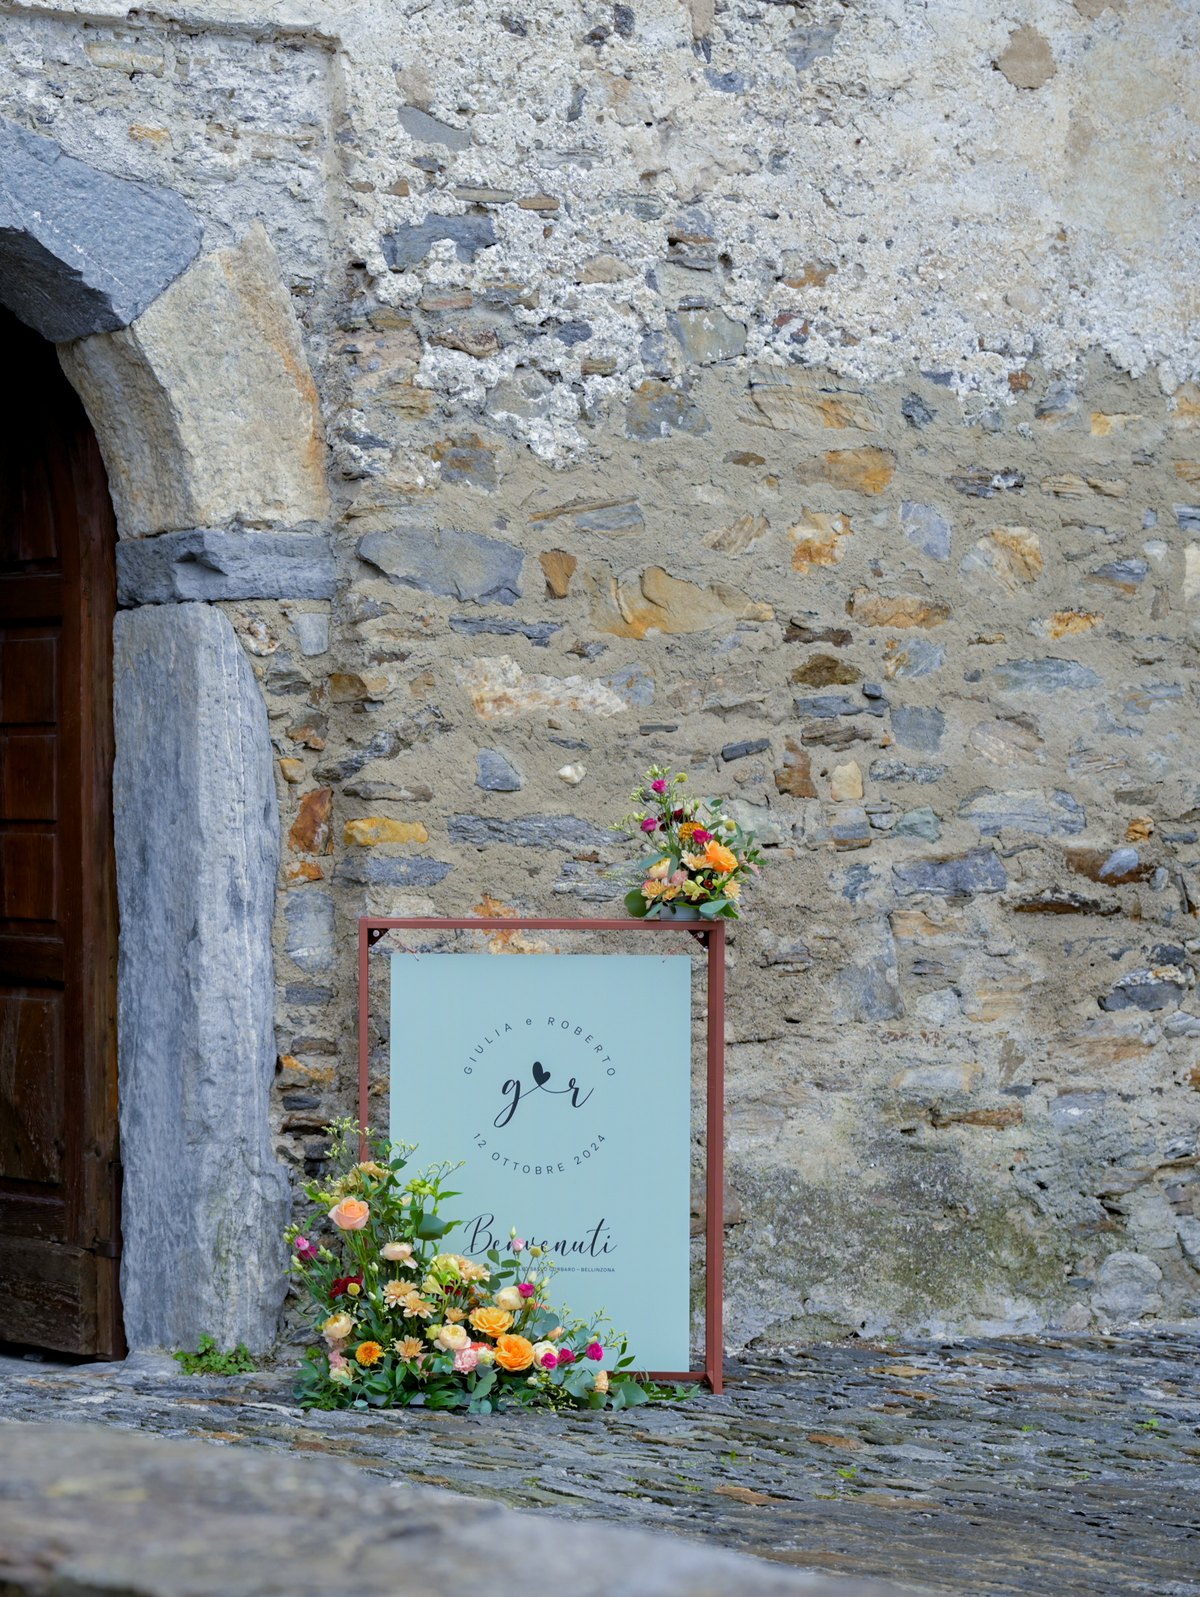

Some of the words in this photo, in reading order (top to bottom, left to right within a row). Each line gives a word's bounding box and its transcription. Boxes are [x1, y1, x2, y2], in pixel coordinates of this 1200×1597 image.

[464, 1023, 512, 1074] GIULIA
[548, 1016, 616, 1076] ROBERTO
[474, 1133, 487, 1148] 12
[492, 1152, 565, 1175] OTTOBRE
[574, 1134, 606, 1165] 2024
